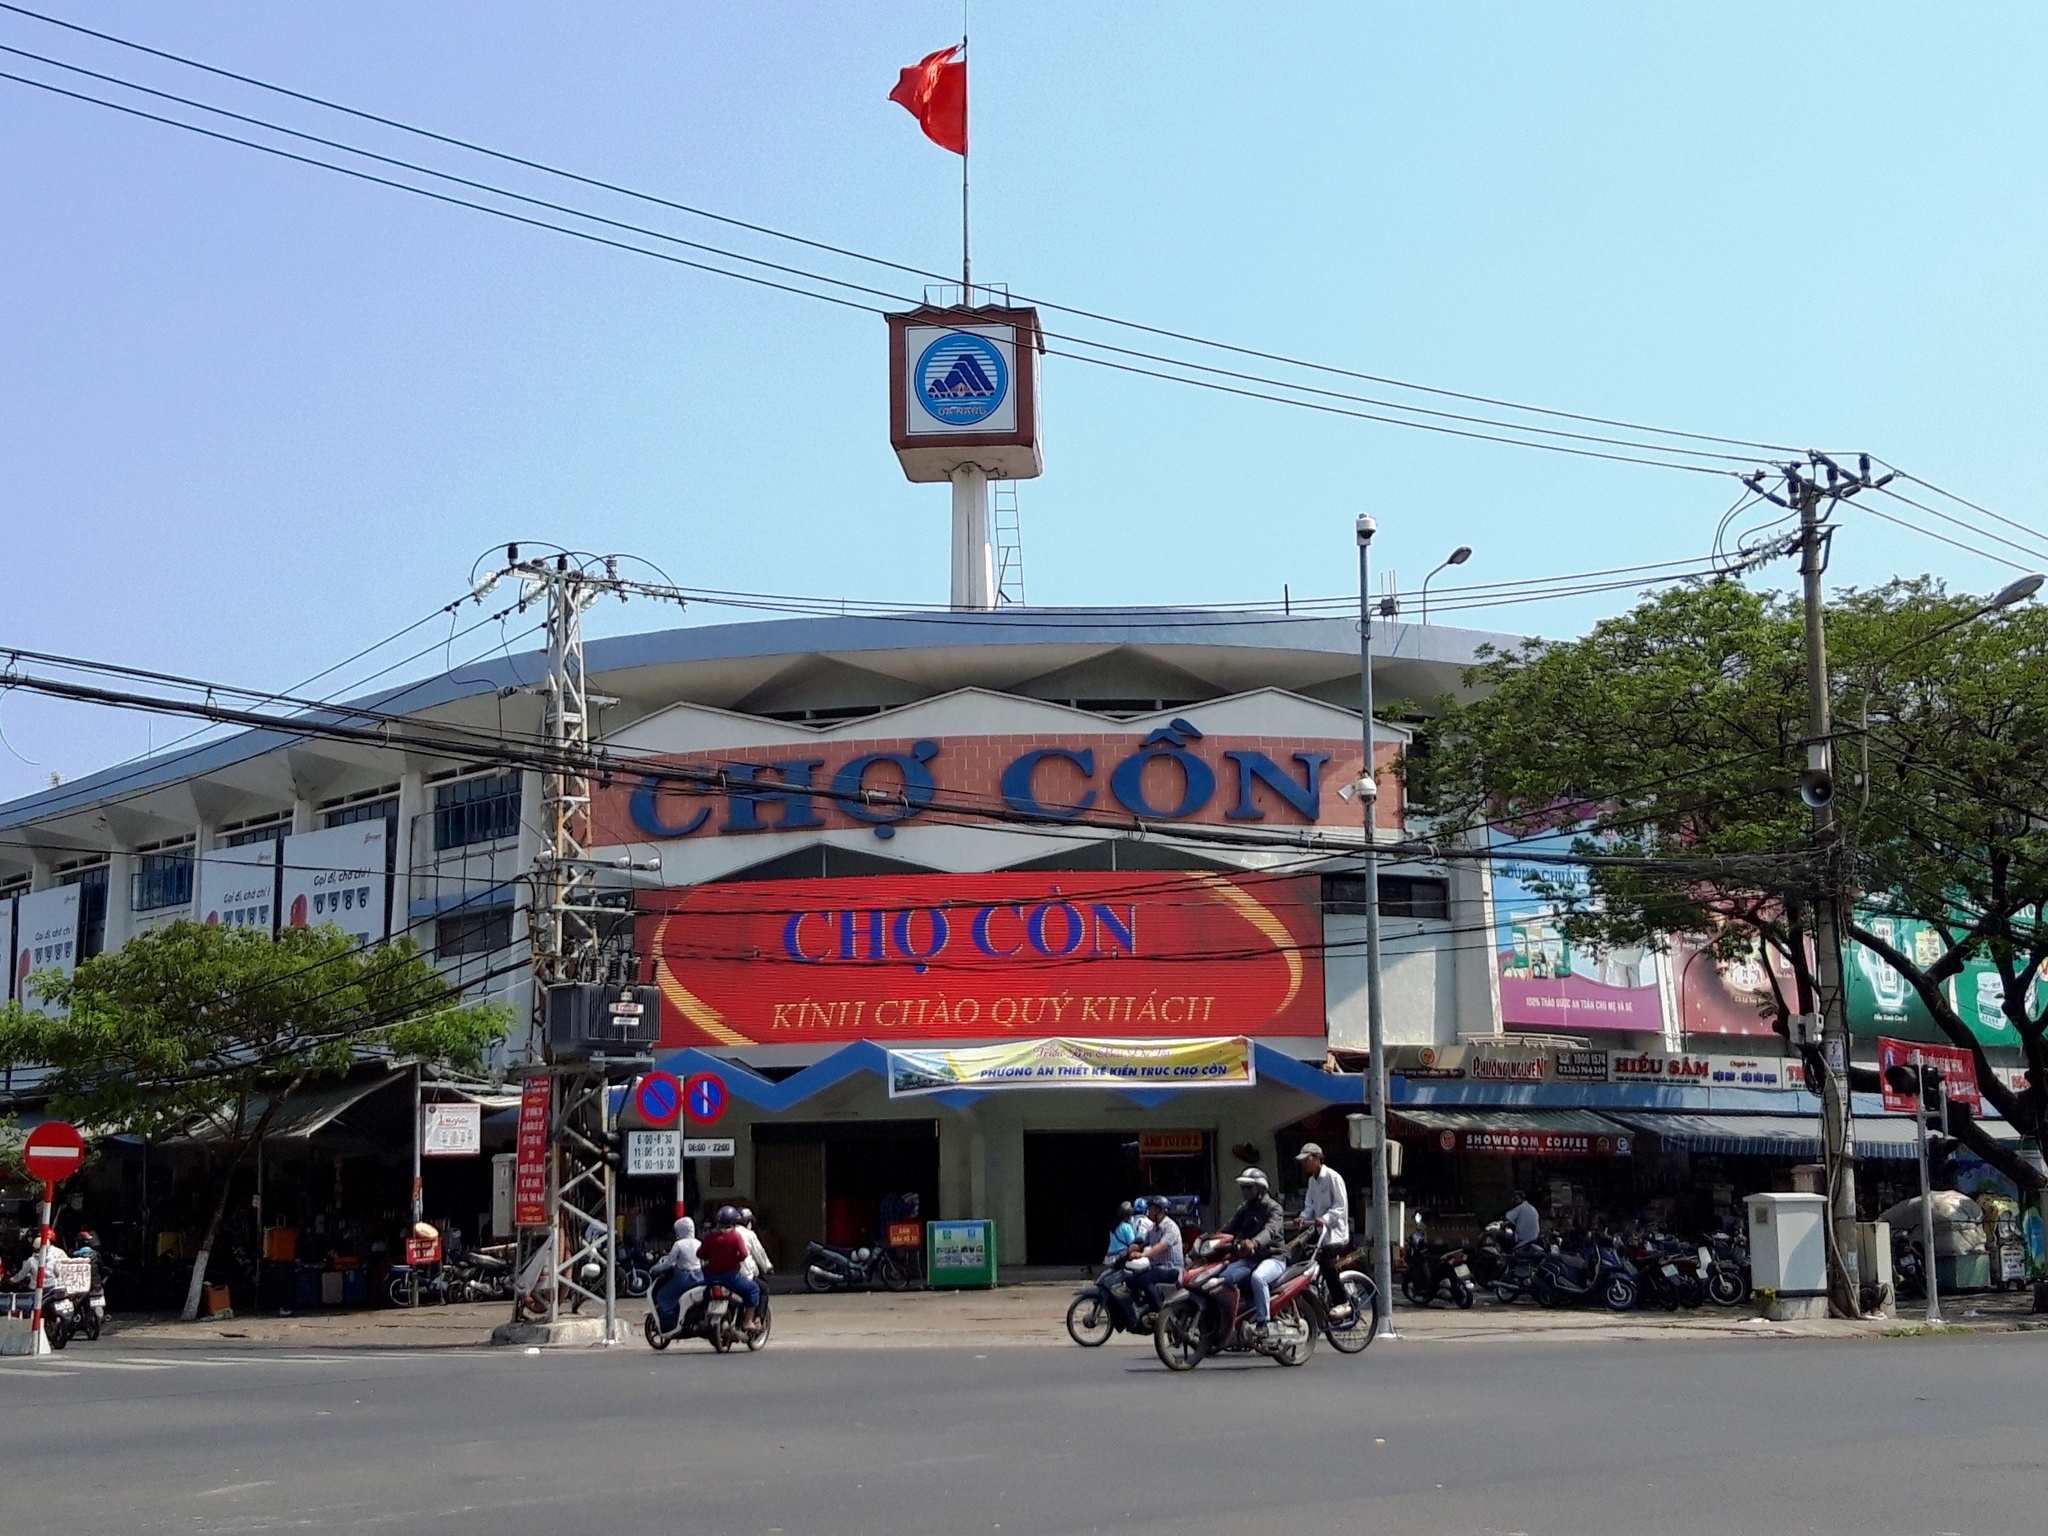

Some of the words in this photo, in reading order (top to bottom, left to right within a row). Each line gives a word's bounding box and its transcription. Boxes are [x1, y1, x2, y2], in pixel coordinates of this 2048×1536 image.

[629, 740, 939, 839] CHỢ
[1001, 718, 1330, 820] CỒN
[315, 892, 368, 914] 0986
[781, 899, 951, 974] CHỢ
[772, 994, 864, 1029] KÍNH
[875, 991, 981, 1026] CHÀO
[998, 993, 1070, 1027] QUÝ
[1081, 988, 1215, 1024] KHÁCH
[980, 1066, 1034, 1078] PHƯƠNG
[1058, 1063, 1089, 1076] THIẾT
[1091, 1062, 1108, 1076] KẾ
[1109, 1062, 1138, 1076] KIẾN
[1140, 1064, 1171, 1076] TRÚC
[1173, 1064, 1199, 1078] CHỢ
[1201, 1061, 1228, 1075] CỒN
[1466, 1134, 1540, 1147] SHOWROOM
[1546, 1136, 1589, 1148] COFFEE
